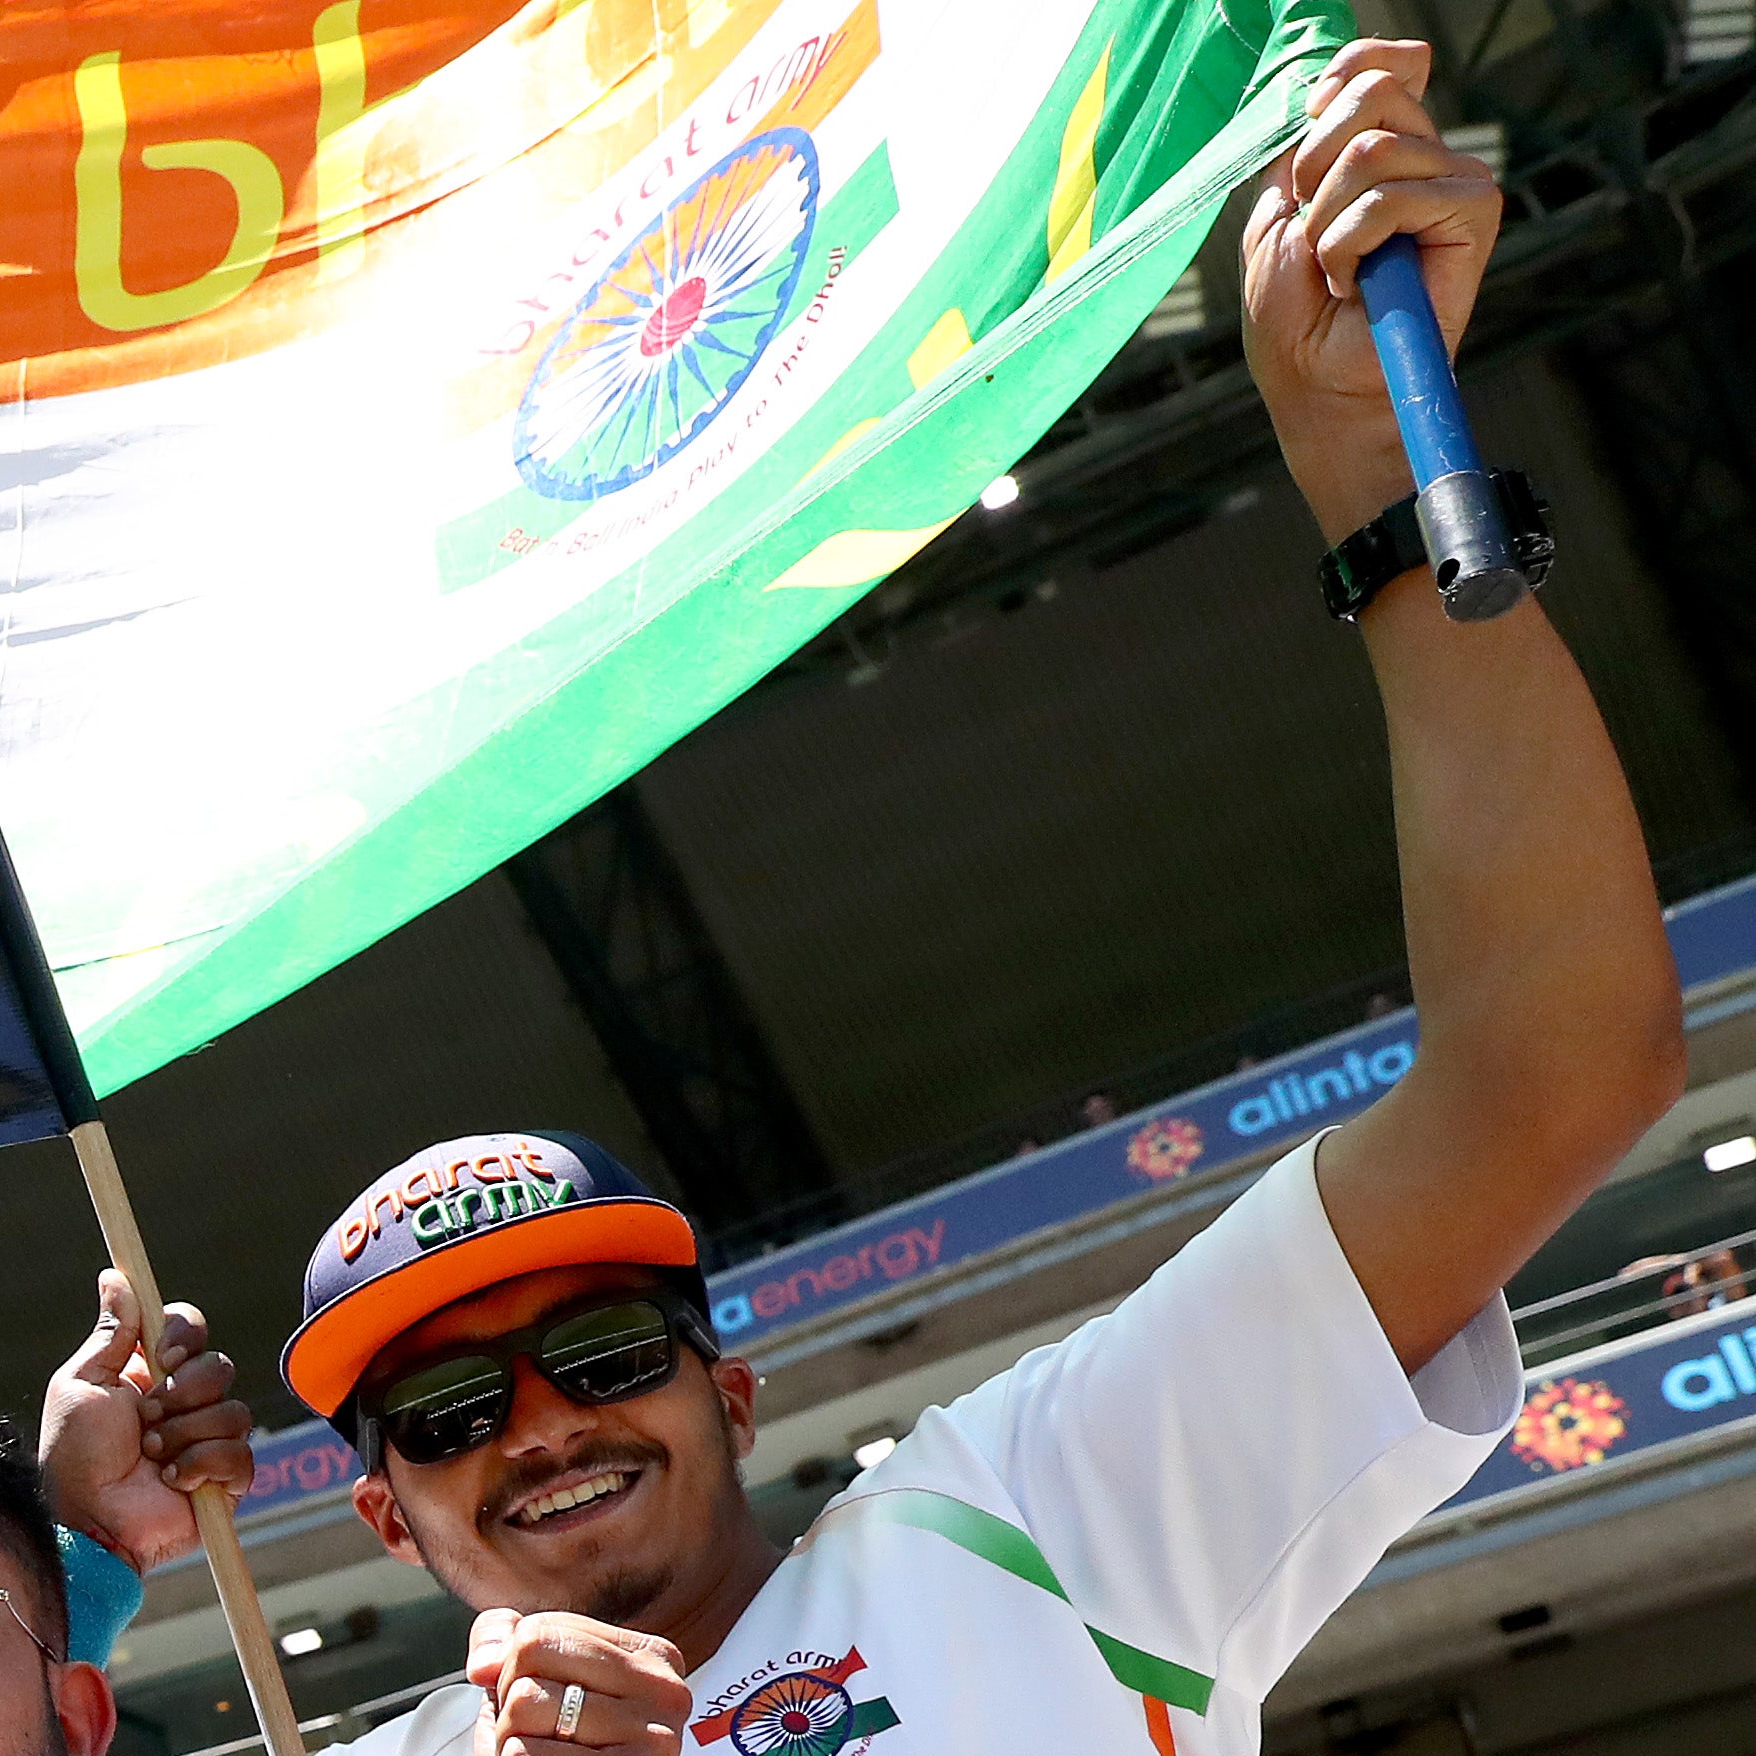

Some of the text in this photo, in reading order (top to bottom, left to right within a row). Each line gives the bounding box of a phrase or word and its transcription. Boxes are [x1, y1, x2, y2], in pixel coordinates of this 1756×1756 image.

[745, 398, 769, 430] to
[776, 335, 809, 388] The
[337, 1141, 554, 1261] bharat
[697, 1659, 781, 1721] bharat
